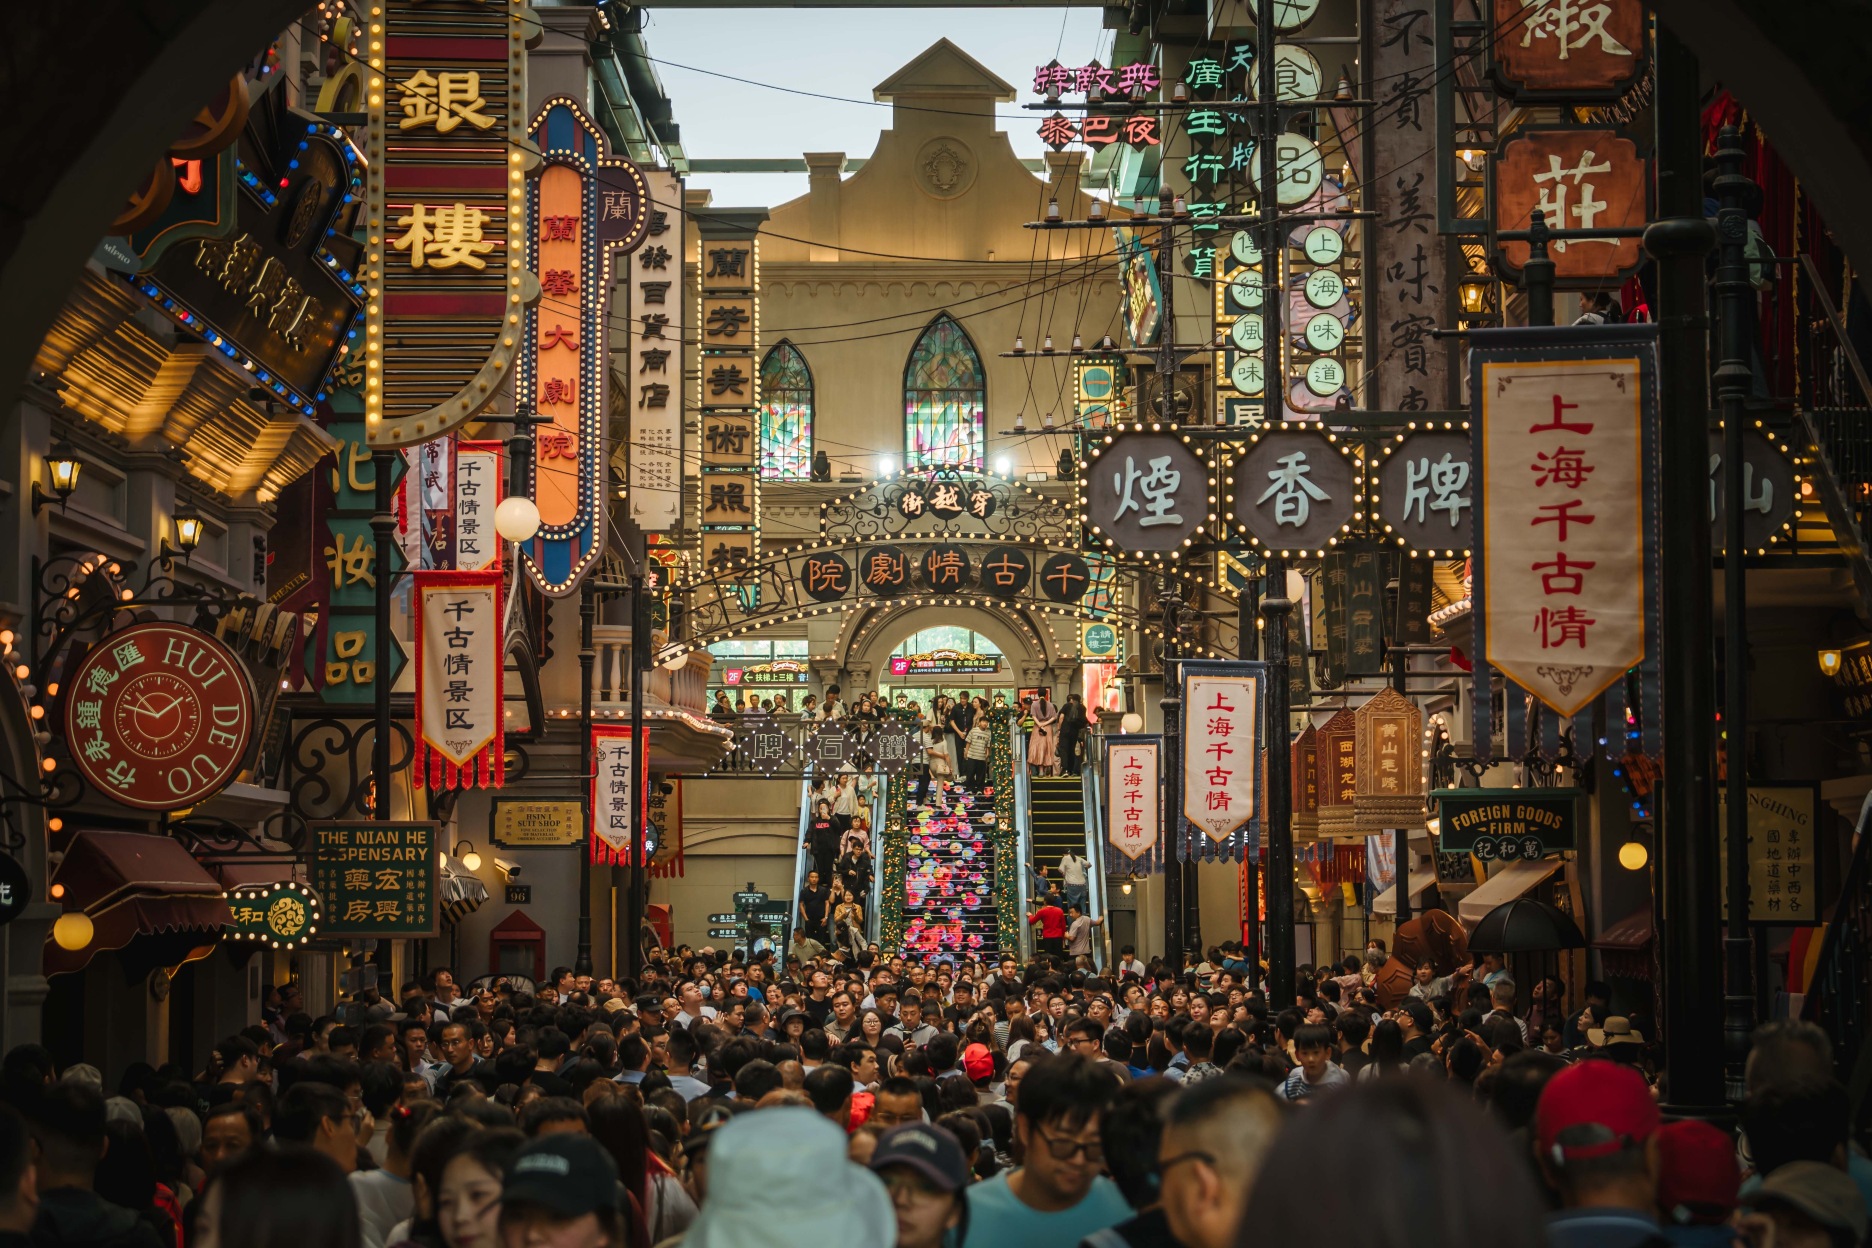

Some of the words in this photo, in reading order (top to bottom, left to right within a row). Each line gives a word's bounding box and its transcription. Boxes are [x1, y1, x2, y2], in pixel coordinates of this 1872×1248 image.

[393, 69, 497, 271] 銀樓
[602, 191, 632, 222] 蘭
[538, 214, 579, 460] 蘭馨大劇院
[1312, 233, 1339, 386] 上海味道
[458, 461, 481, 554] 千古情景区
[1529, 394, 1596, 649] 上海千古情
[162, 637, 227, 690] HUI
[208, 703, 240, 750] DE
[443, 599, 475, 731] 千古情景区
[728, 672, 738, 682] 2F
[895, 662, 906, 671] 2F
[609, 746, 629, 829] 千古情景区
[1205, 692, 1235, 811] 上海千古情
[318, 831, 348, 845] THE
[355, 831, 399, 845] NIAN
[406, 831, 427, 845] HE
[1123, 756, 1143, 838] 上海千古情
[1451, 804, 1511, 831] FOREIGN
[1516, 804, 1563, 829] GOODS
[1490, 822, 1525, 834] FIRM
[318, 847, 428, 862] DSPENSARY
[510, 892, 526, 902] 96
